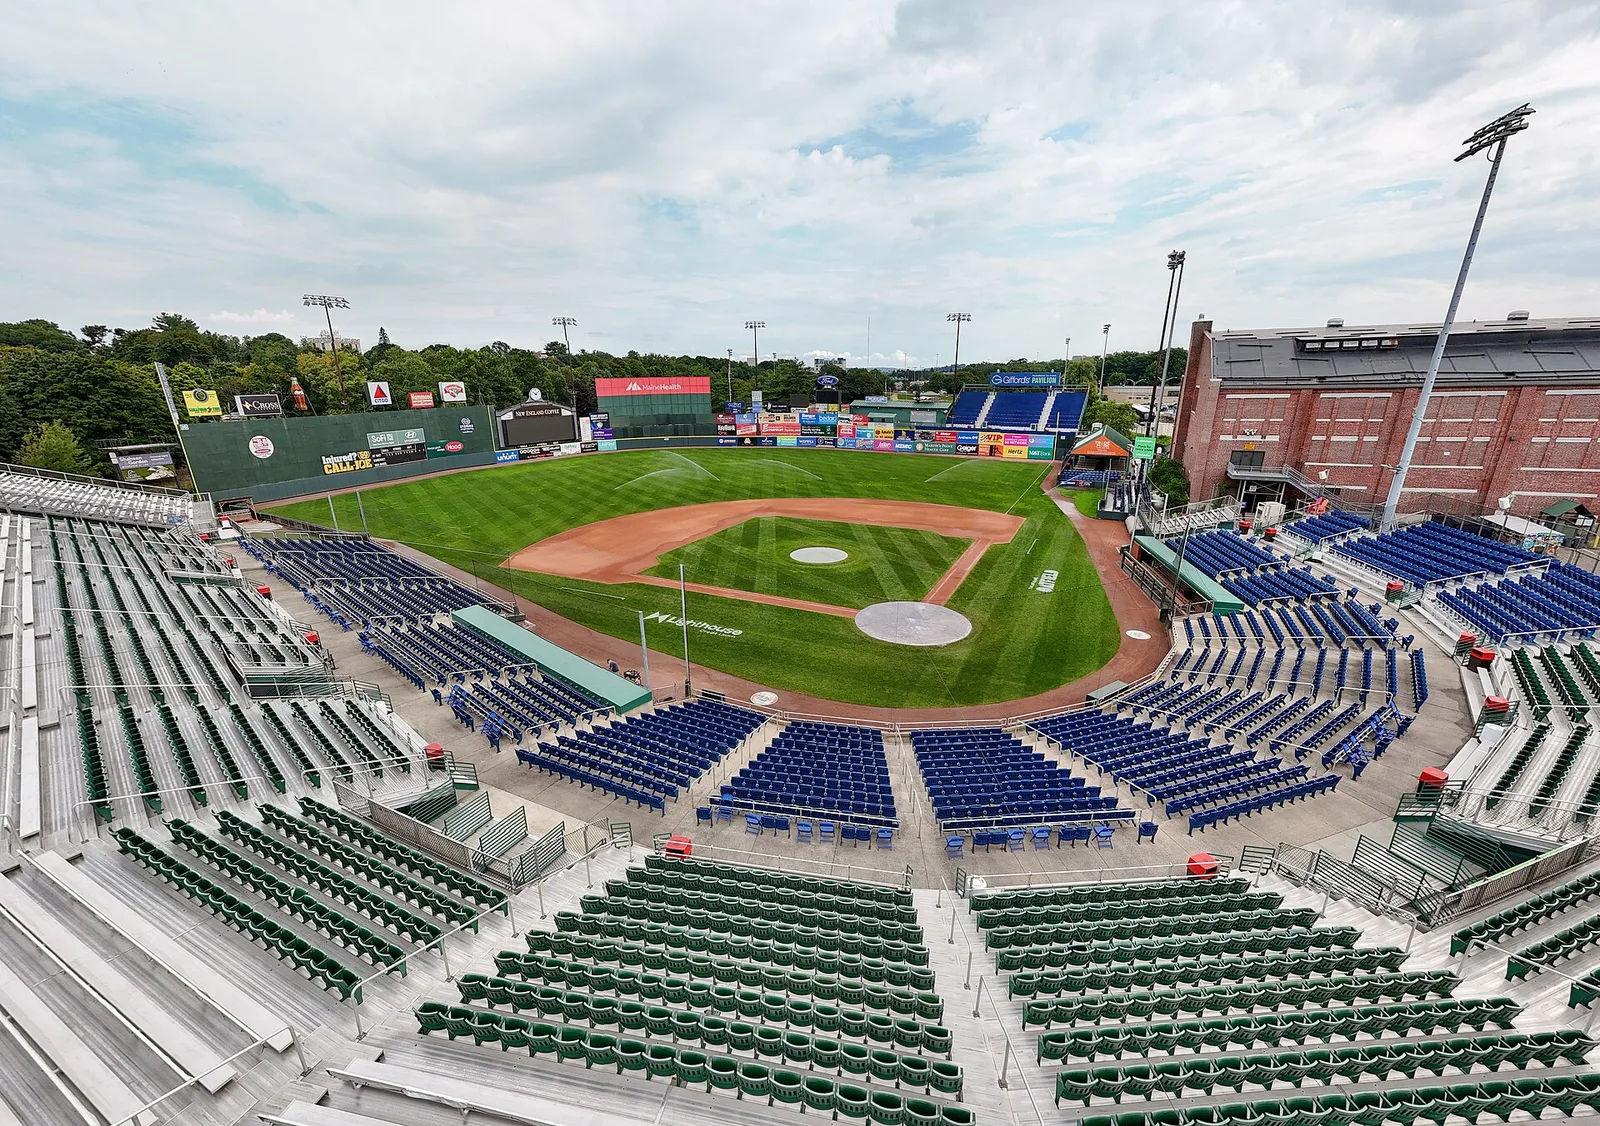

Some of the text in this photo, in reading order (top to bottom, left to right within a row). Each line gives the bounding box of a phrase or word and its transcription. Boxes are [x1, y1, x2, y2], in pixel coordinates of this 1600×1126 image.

[371, 434, 386, 443] SoFi
[321, 452, 357, 465] Injured?
[497, 452, 517, 461] unum
